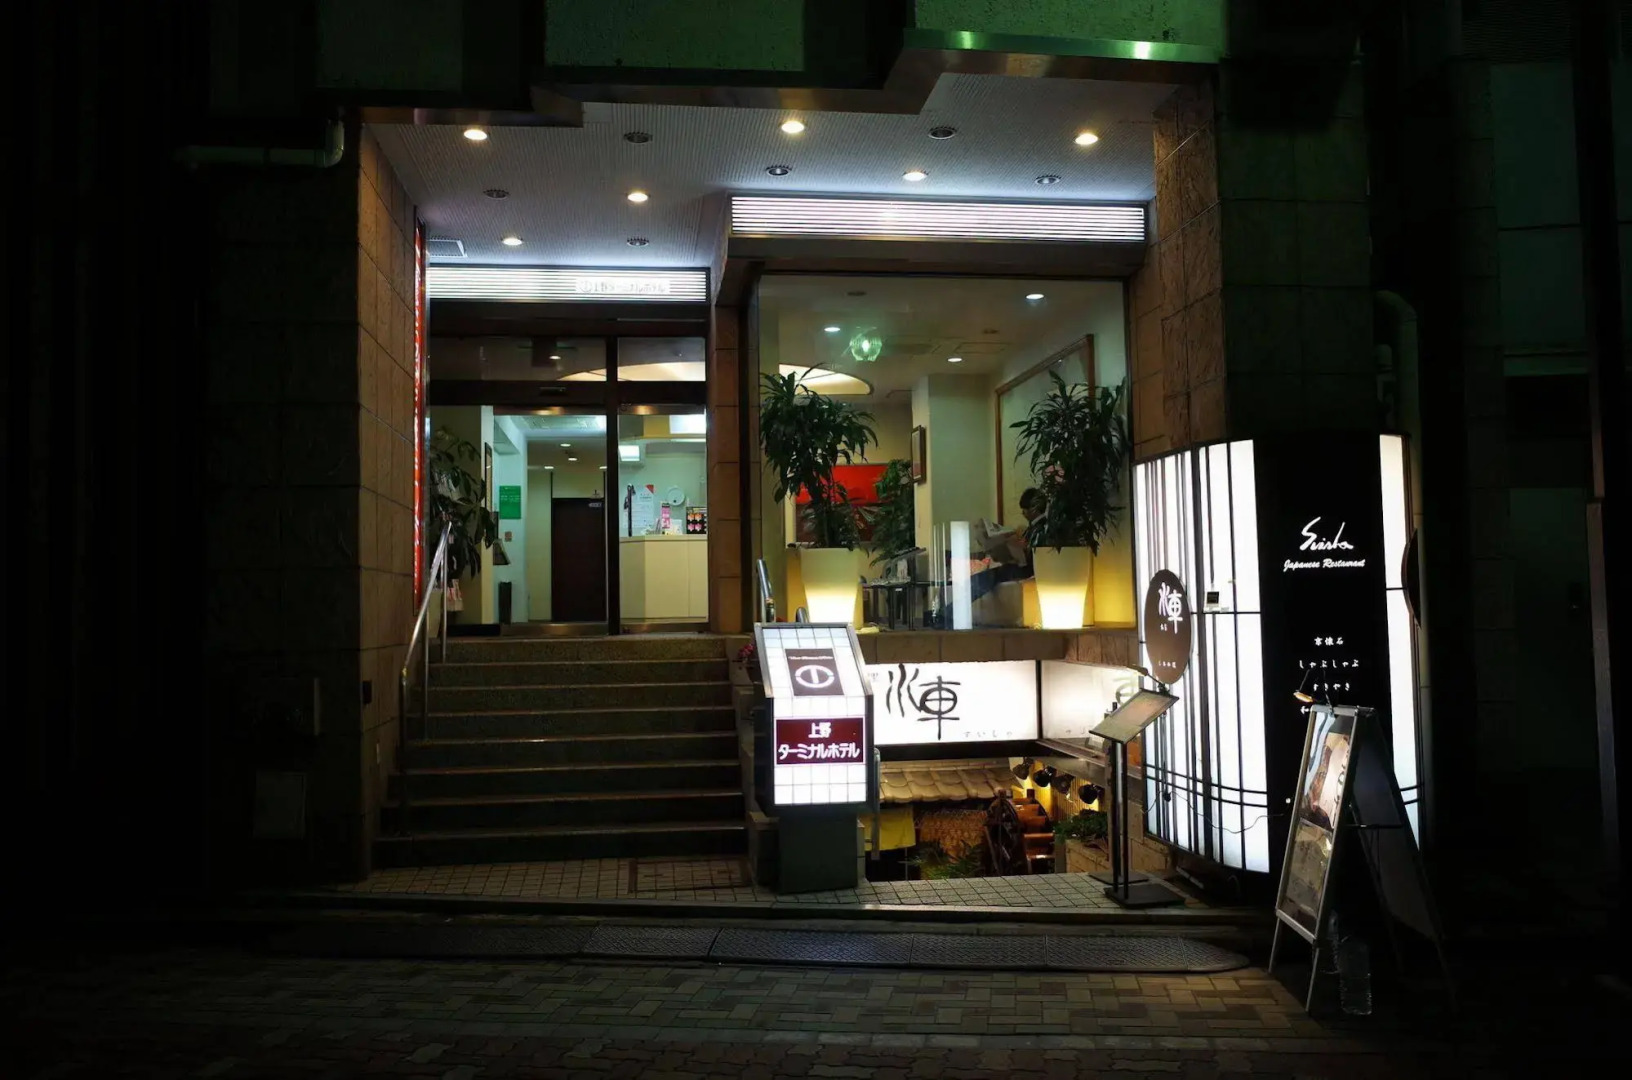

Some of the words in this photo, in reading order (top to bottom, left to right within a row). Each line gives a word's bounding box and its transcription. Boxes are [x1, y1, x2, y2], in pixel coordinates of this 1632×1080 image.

[1283, 559, 1320, 572] Japanese
[1322, 558, 1366, 568] Restaurant
[1299, 659, 1359, 669] しゃぶしゃぶ
[808, 722, 832, 738] 上野
[778, 742, 860, 760] ターミナルホテル
